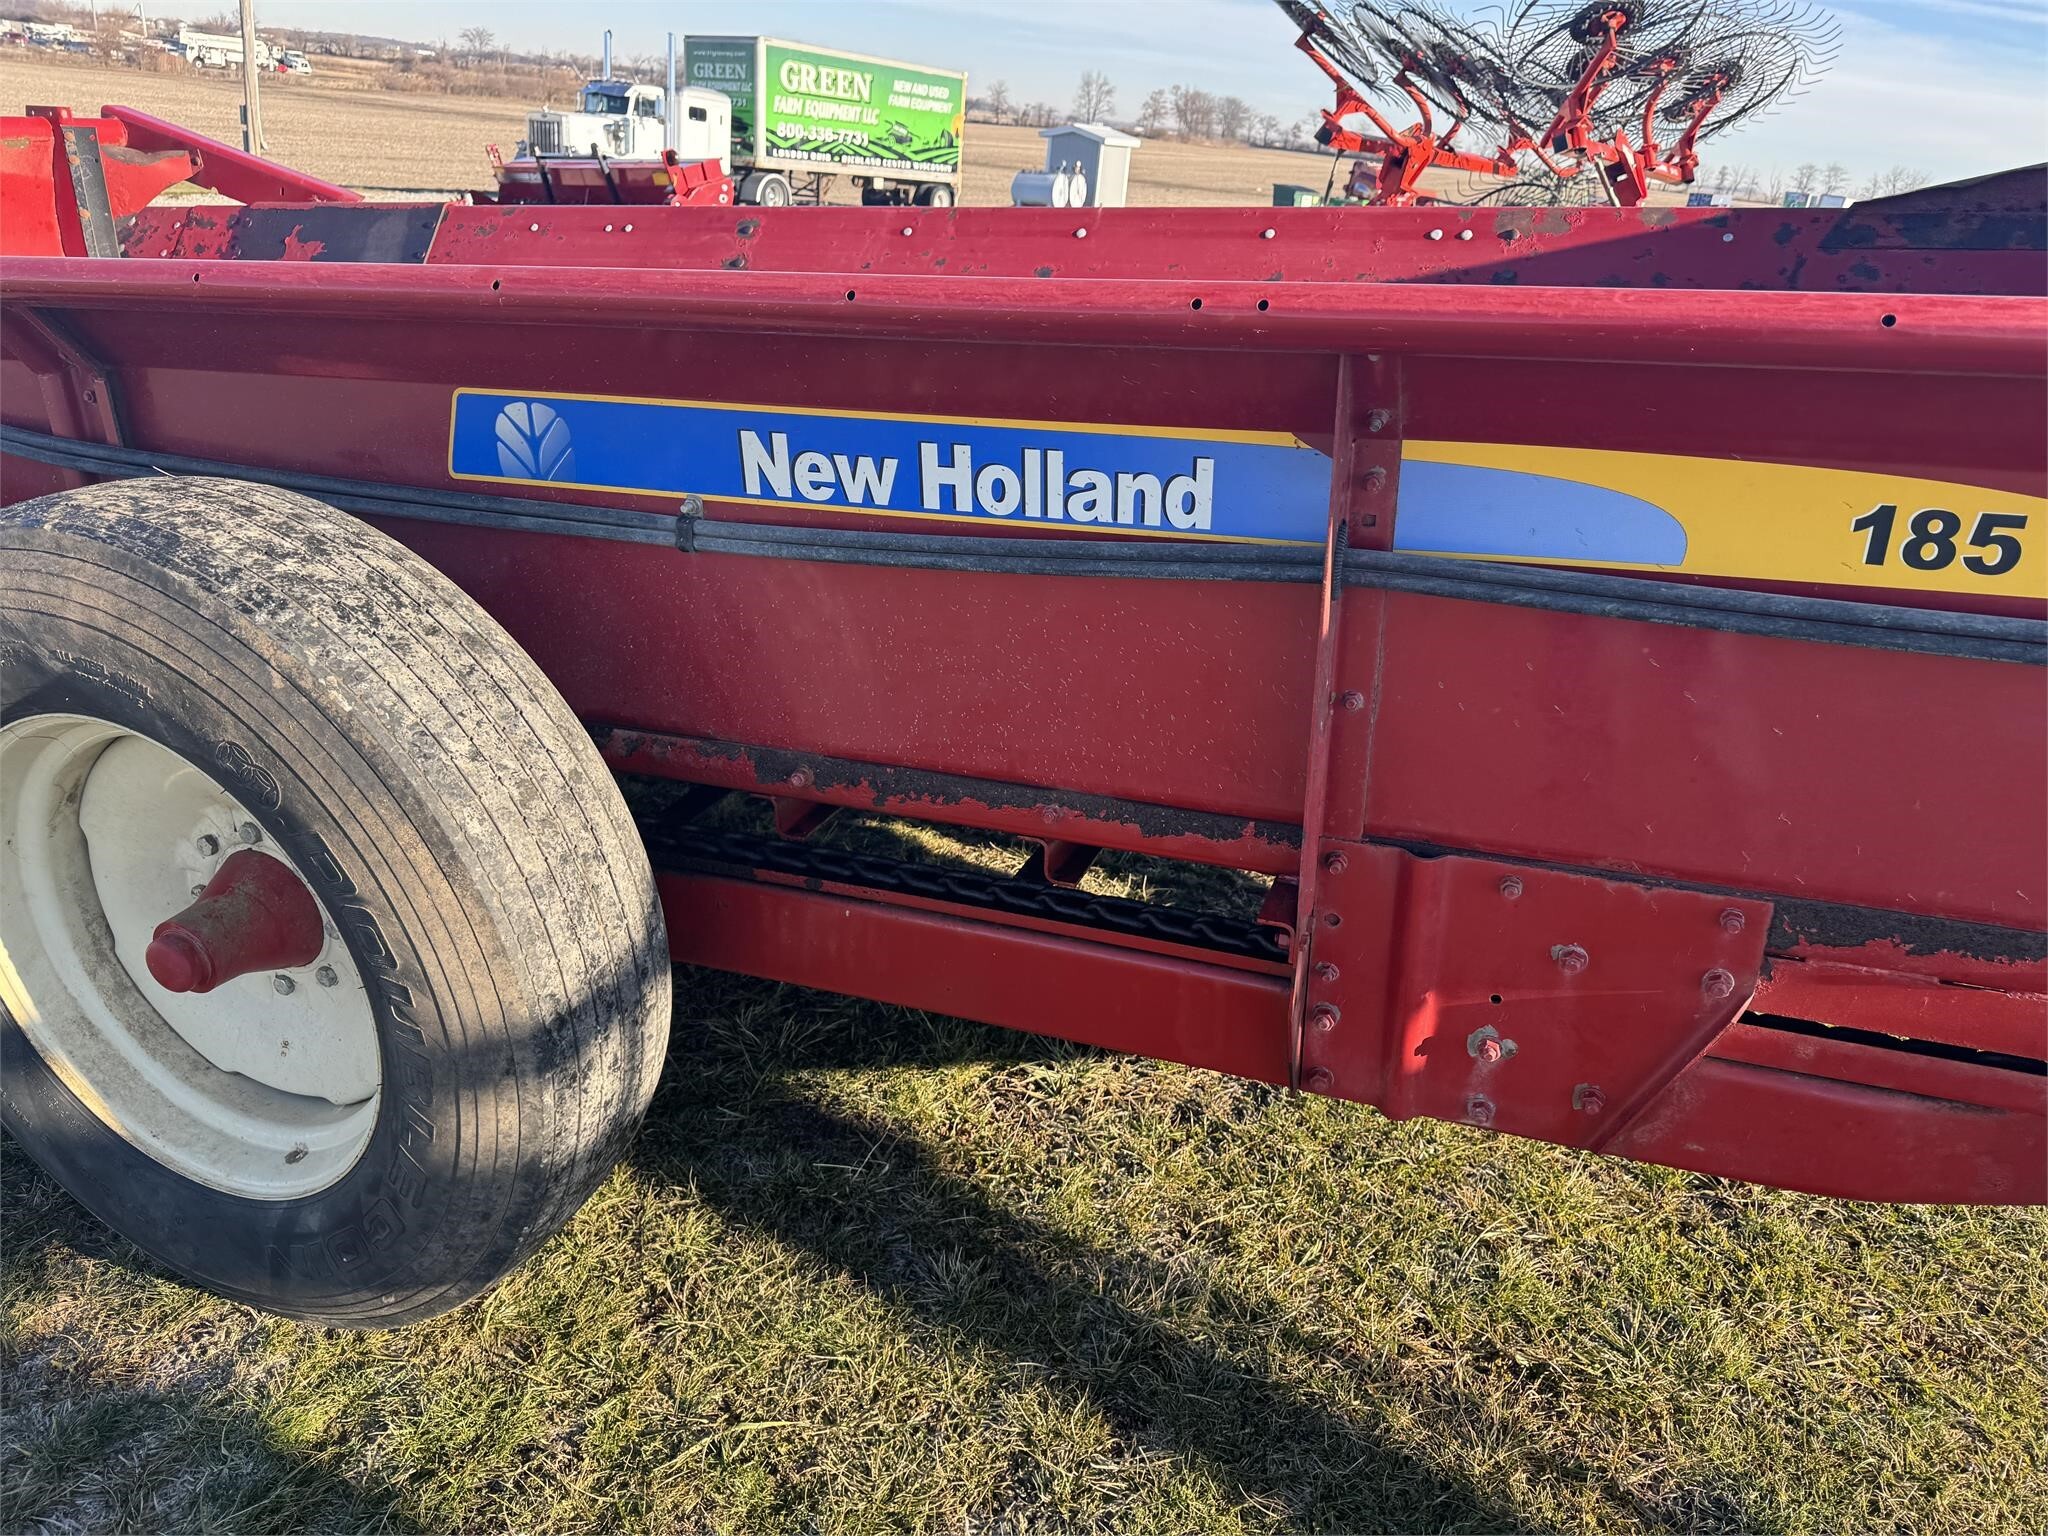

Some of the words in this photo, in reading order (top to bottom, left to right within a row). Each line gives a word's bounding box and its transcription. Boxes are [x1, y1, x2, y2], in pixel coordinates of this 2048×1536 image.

[693, 62, 747, 79] GREEN
[780, 60, 873, 103] GREEN
[887, 93, 912, 109] FARM
[910, 97, 954, 114] EQUIPMENT
[893, 79, 913, 93] NEW
[911, 82, 929, 96] AND
[928, 85, 950, 100] USED
[773, 95, 804, 116] FARM
[804, 99, 862, 123] EQUIPMENT
[861, 106, 881, 125] LLC
[739, 429, 897, 507] New
[916, 441, 1214, 531] Holland
[1851, 503, 2029, 576] 185
